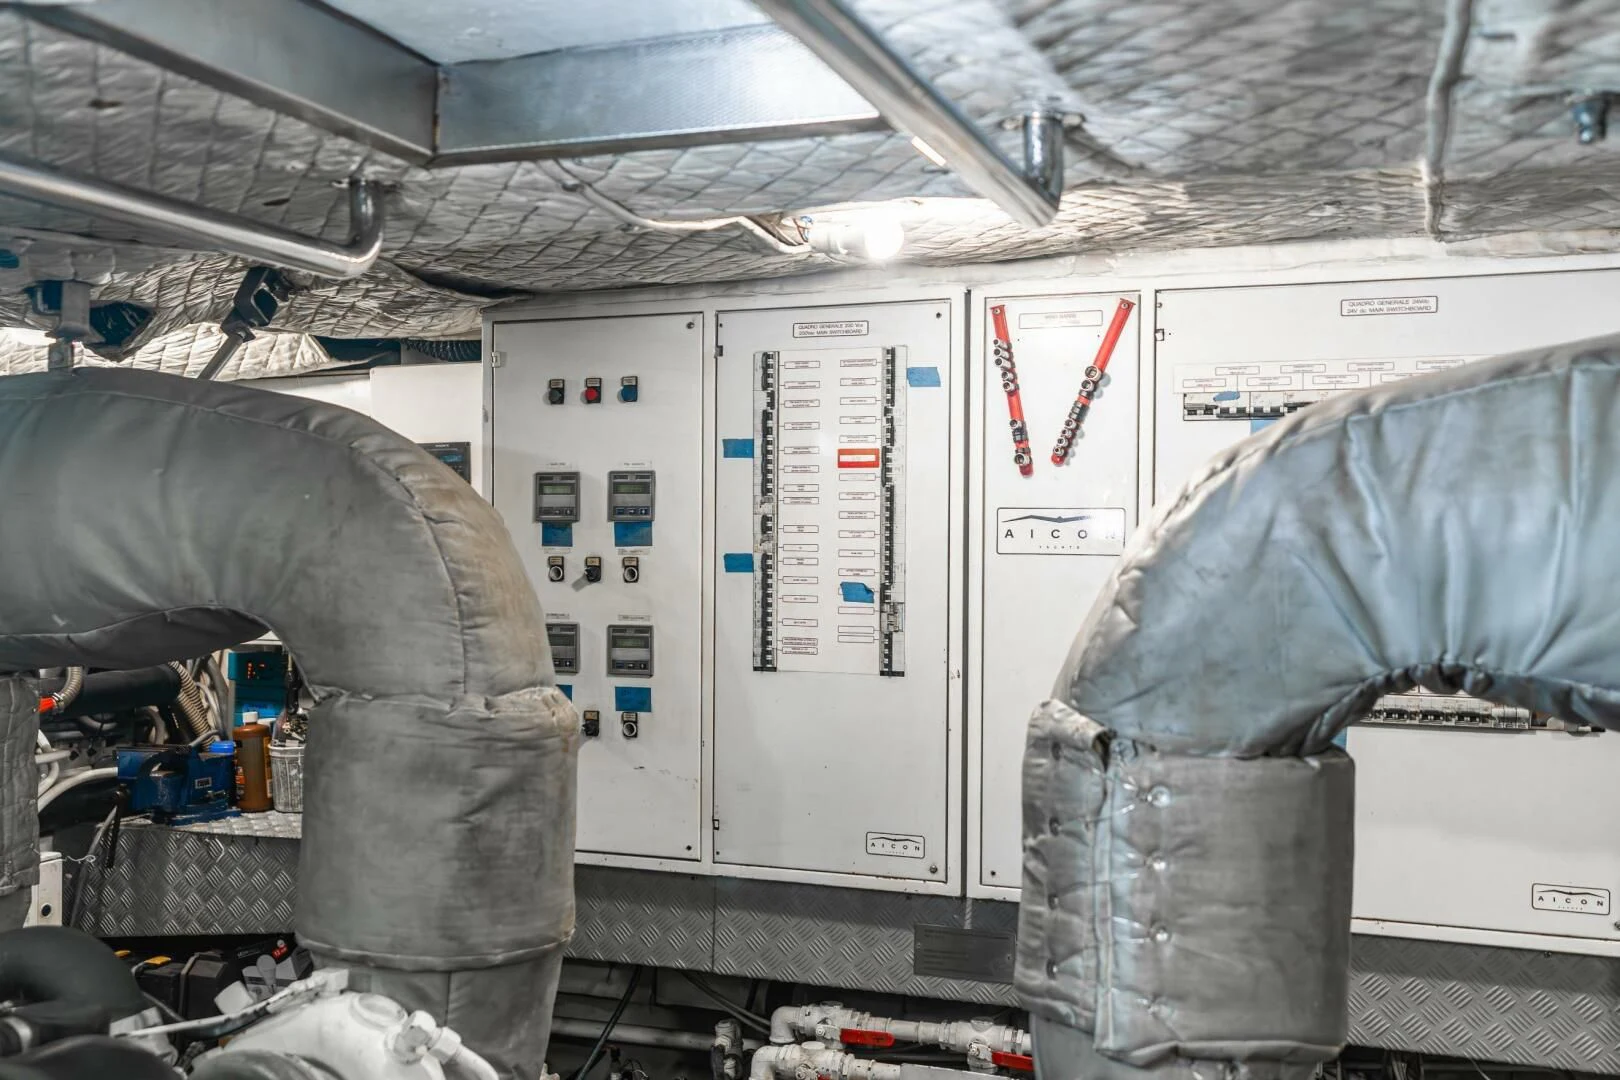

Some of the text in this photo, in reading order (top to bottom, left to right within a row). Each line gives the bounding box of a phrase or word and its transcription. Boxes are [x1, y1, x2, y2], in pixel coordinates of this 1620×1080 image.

[1004, 529, 1116, 540] AICO
[870, 842, 920, 851] AICON
[1538, 895, 1604, 907] AICON
